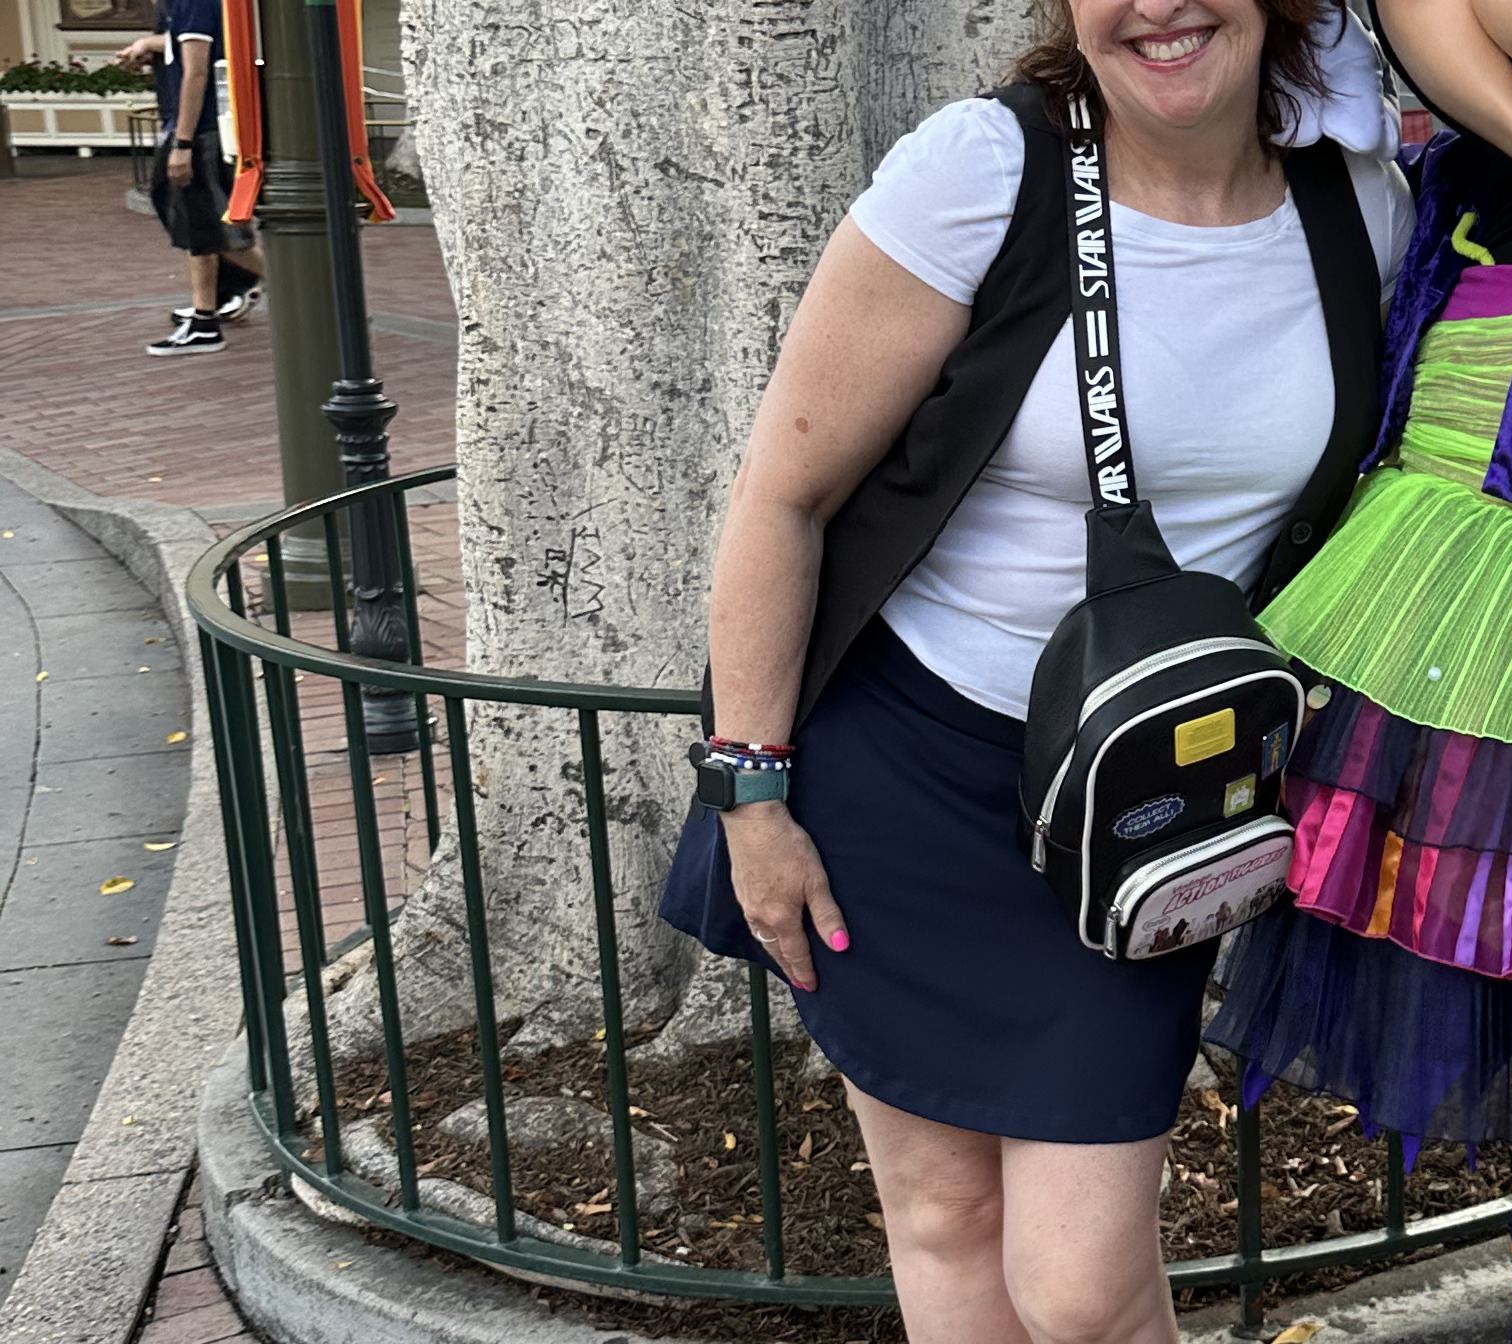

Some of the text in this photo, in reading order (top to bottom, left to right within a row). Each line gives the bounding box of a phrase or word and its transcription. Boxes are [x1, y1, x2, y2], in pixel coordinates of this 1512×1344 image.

[1070, 138, 1110, 299] STAR WARS
[1085, 365, 1122, 464] WARS
[1123, 809, 1175, 834] THEM ALL!
[1127, 802, 1172, 826] COLLECT
[1162, 846, 1288, 915] ACTION FIGURES
